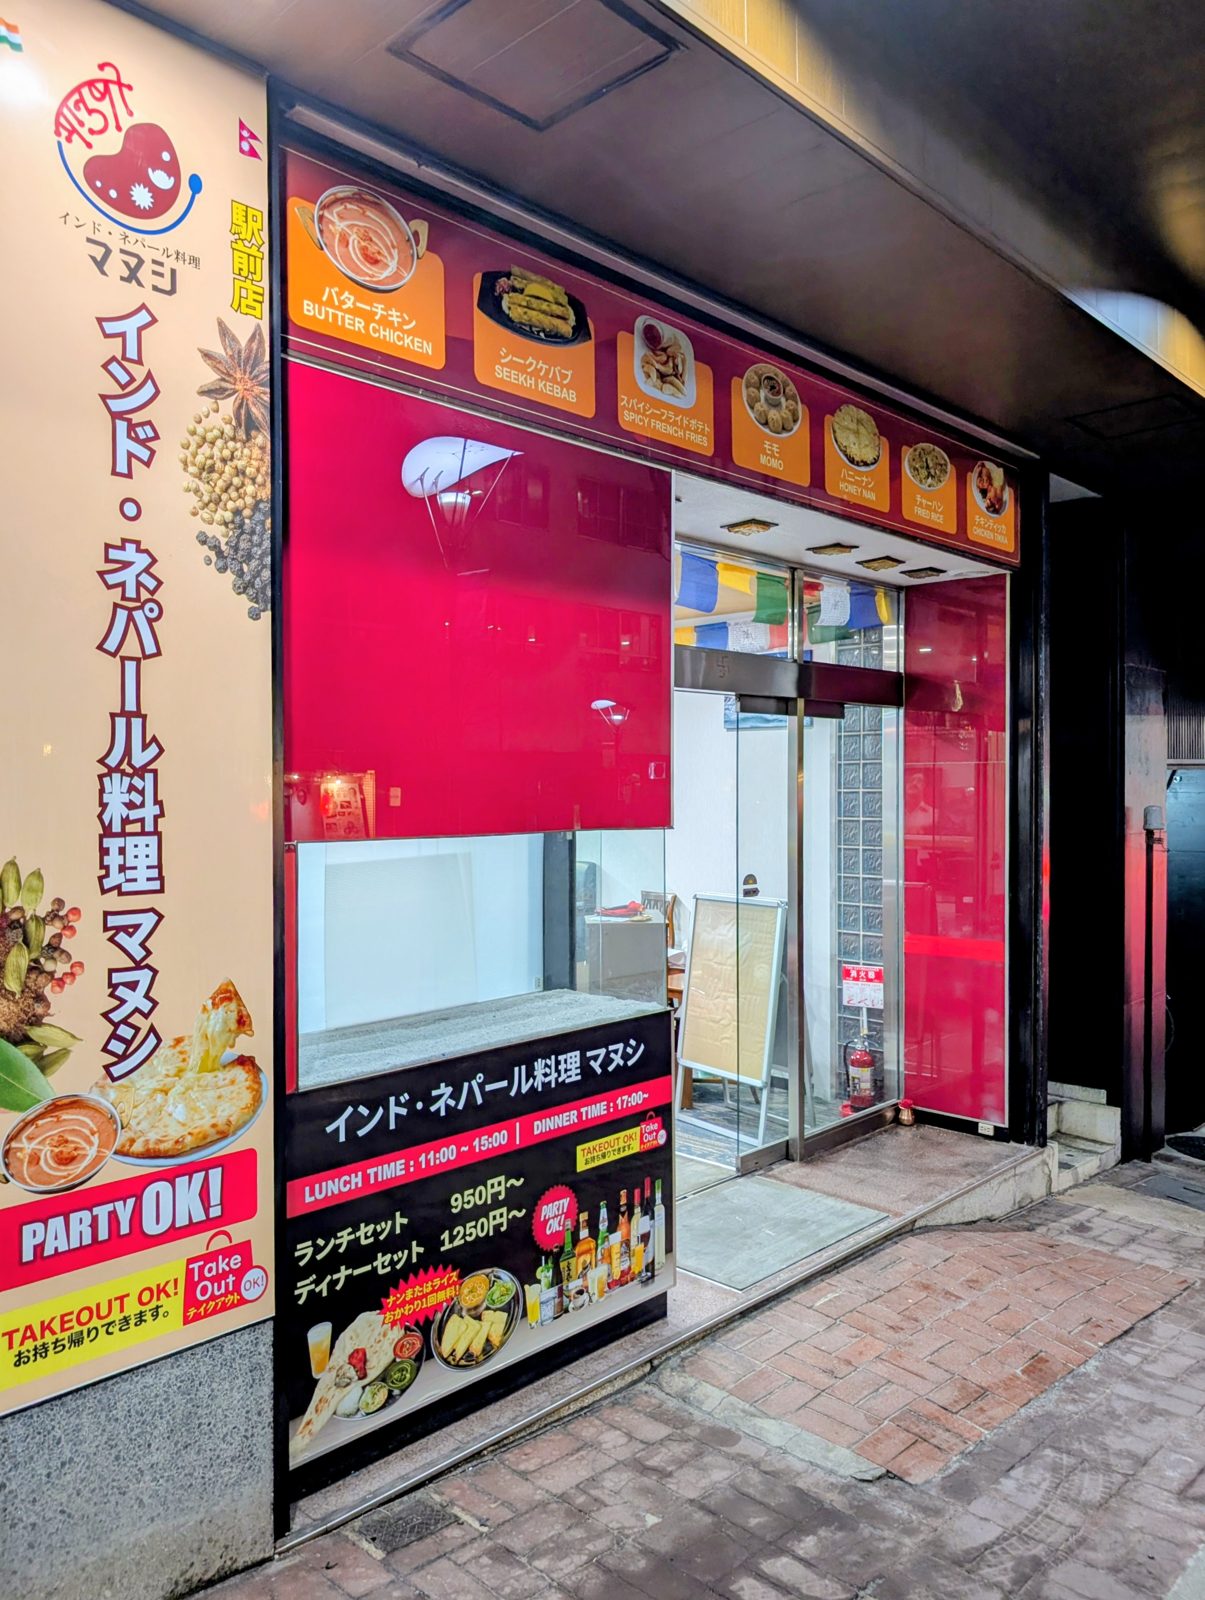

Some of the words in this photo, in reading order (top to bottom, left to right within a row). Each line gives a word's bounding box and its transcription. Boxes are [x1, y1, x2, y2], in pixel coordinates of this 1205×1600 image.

[59, 211, 201, 270] インド・ネパール料理
[85, 236, 178, 296] マヌシ
[230, 199, 265, 320] 駅前店
[322, 286, 417, 331] バターチキン
[303, 300, 365, 335] BUTTER
[369, 323, 433, 356] CHICKEN
[494, 364, 535, 390] SEEKH
[538, 378, 576, 402] KEBAB
[499, 346, 574, 385] シークケバブ
[620, 395, 711, 434] スパイシーフライドポテト
[623, 410, 649, 428] SPICY
[651, 418, 684, 439] FRENCH
[686, 429, 708, 446] FRIES
[759, 455, 784, 470] MOMO
[763, 440, 779, 456] モモ
[839, 481, 860, 496] HONEY
[861, 486, 876, 500] NAN
[840, 468, 874, 487] ハニーナン
[914, 505, 930, 520] FRIED
[931, 513, 944, 524] RICE
[915, 494, 943, 512] チャーハン
[95, 302, 166, 897] インド・ネパール料理
[99, 907, 166, 1083] マヌシ
[325, 1049, 581, 1143] インド・ネパール料理
[586, 1038, 646, 1075] マヌシ
[533, 1110, 578, 1135] DINNER
[640, 1122, 658, 1133] Take
[643, 1131, 656, 1142] Out
[581, 1137, 620, 1157] TAKEOUT
[623, 1131, 637, 1142] OK!
[304, 1172, 363, 1204] LUNCH
[418, 1144, 457, 1167] 11:00
[472, 1130, 508, 1153] 15:00
[19, 1195, 137, 1265] PARTY
[141, 1166, 224, 1237] OK!
[540, 1197, 569, 1221] PARTY
[546, 1215, 564, 1235] OK!
[293, 1210, 409, 1267] ランチセット
[188, 1252, 243, 1283] Take
[243, 1275, 264, 1292] OK!
[293, 1242, 425, 1306] ディナーセット
[187, 1293, 240, 1319] テイクアウト
[195, 1274, 236, 1301] Out
[386, 1271, 459, 1308] ナンまたはライス
[1, 1292, 130, 1351] TAKEOUT
[137, 1277, 178, 1305] OK!
[13, 1304, 170, 1368] お持ち帰りできます。
